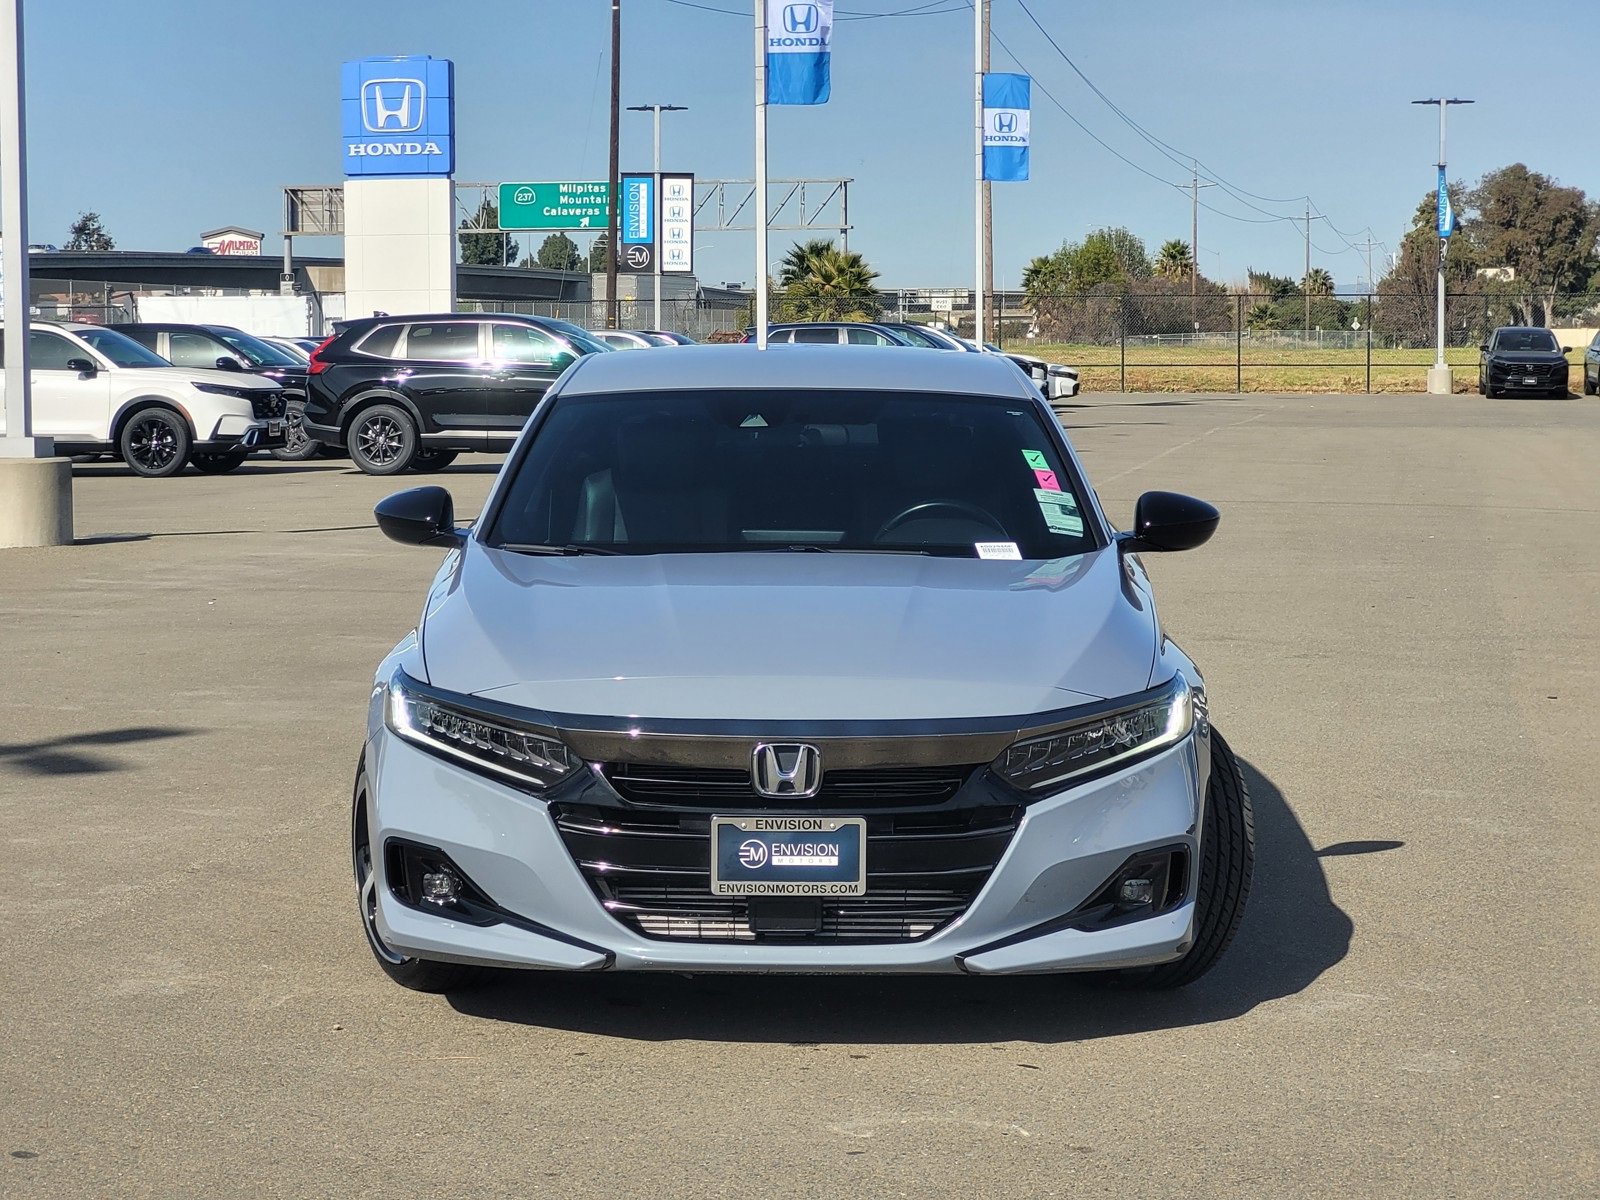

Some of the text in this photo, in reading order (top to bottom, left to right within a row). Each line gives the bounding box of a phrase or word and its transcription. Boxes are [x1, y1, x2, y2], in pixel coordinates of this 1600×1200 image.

[769, 37, 829, 46] HONDA
[348, 142, 442, 156] HONDA
[559, 184, 606, 194] Milpitas
[517, 193, 532, 201] 237
[543, 207, 600, 216] Calaveras
[629, 183, 640, 239] ENVISION
[755, 819, 822, 830] ENVISION
[771, 844, 838, 856] ENVISION
[718, 884, 858, 894] ENVISIONMOTORS.COM
